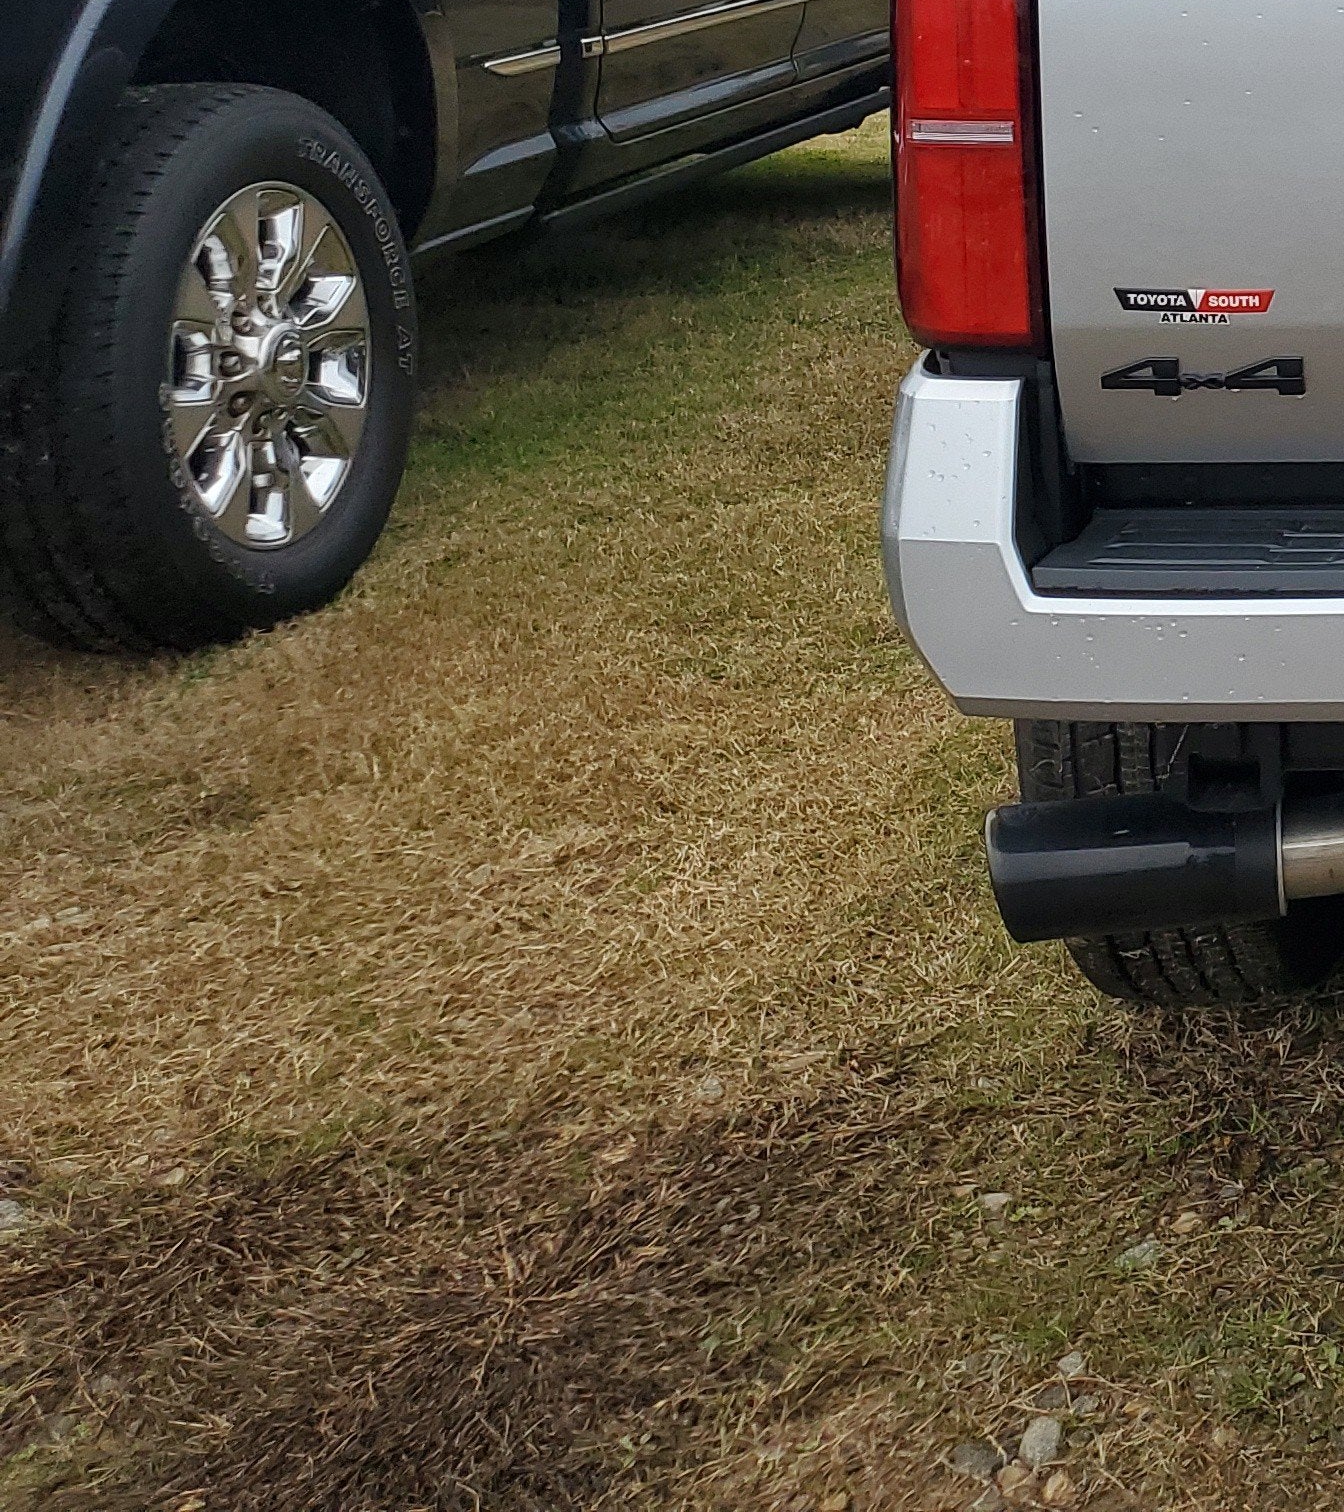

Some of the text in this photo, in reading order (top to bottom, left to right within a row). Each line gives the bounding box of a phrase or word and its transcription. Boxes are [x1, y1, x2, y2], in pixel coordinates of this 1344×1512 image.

[300, 138, 414, 376] TRANSFORCE AT
[1127, 293, 1260, 307] TOYOTA SOUTH
[1161, 313, 1228, 324] ATLANTA
